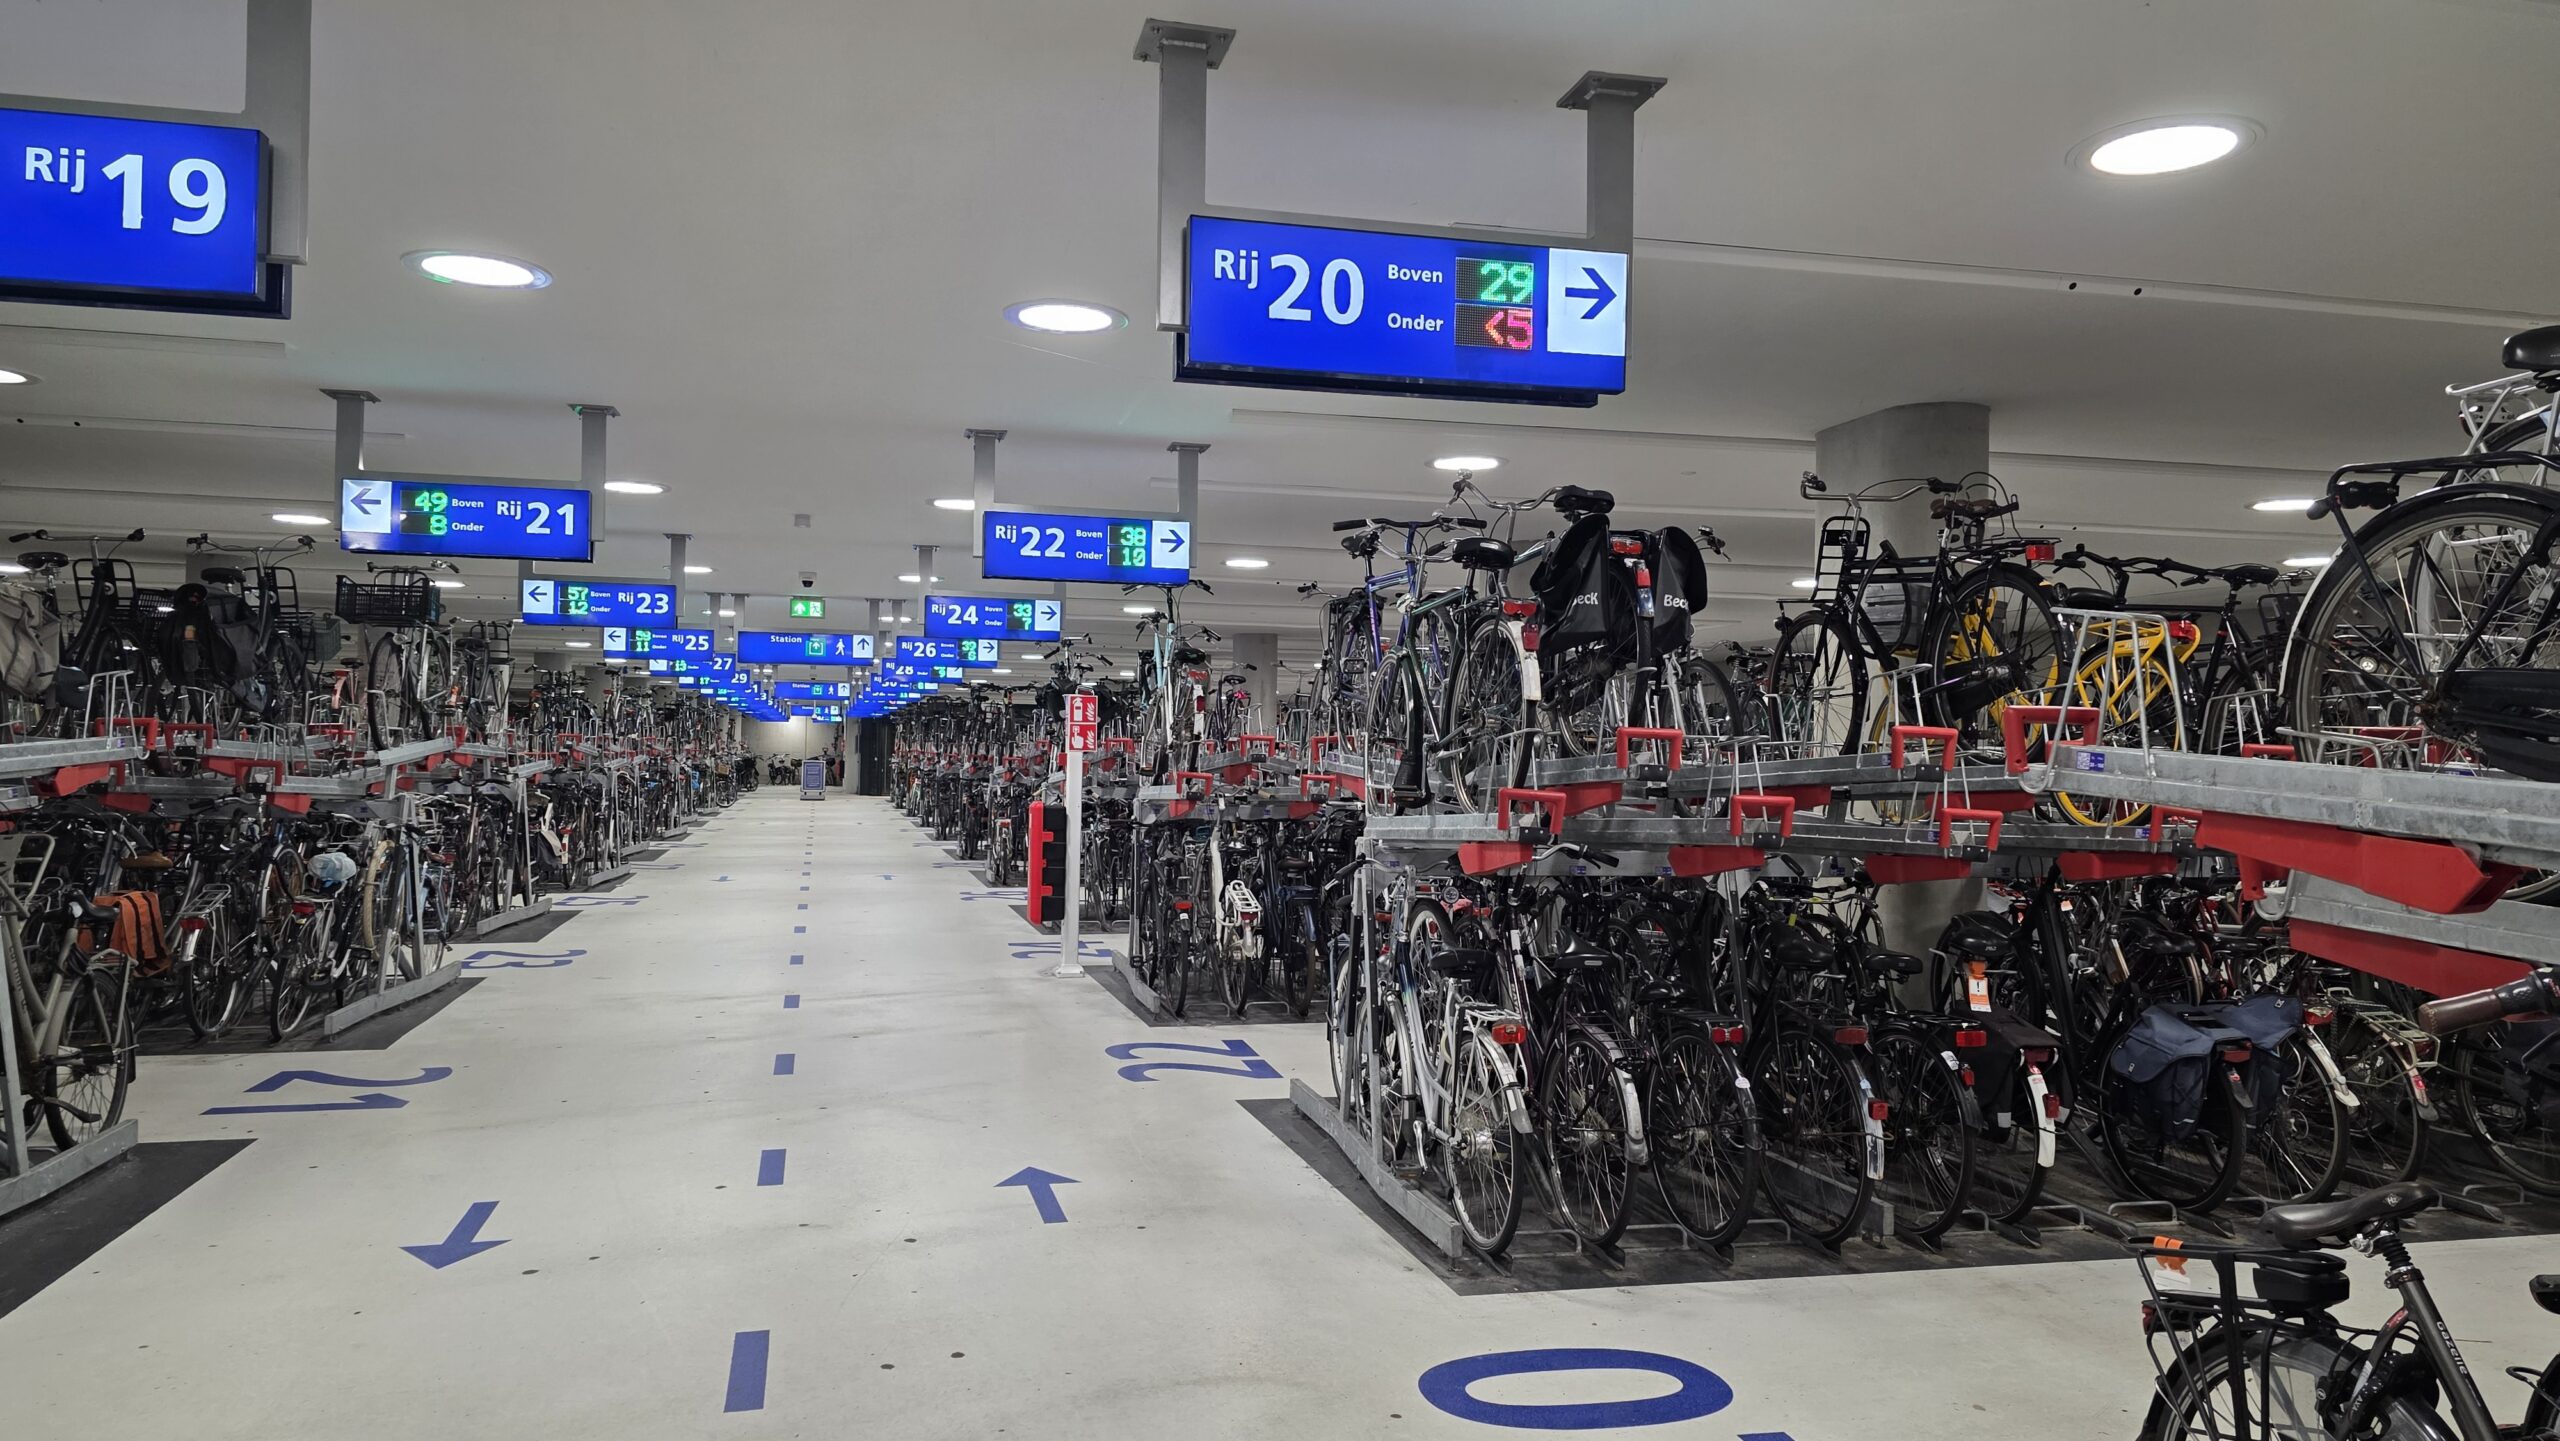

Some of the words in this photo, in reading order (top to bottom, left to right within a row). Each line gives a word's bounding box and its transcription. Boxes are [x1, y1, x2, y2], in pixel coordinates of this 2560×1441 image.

[25, 146, 86, 193] Rij
[101, 153, 227, 235] 19
[1213, 248, 1260, 290] Rij
[1267, 253, 1366, 326] 20
[1387, 264, 1443, 284] Boven
[1479, 261, 1534, 304] 29
[1386, 312, 1444, 333] Onder
[414, 491, 448, 513] 49
[451, 498, 485, 509] Boven
[496, 500, 522, 520] Rij
[525, 501, 575, 536] 21
[429, 515, 448, 535] 8
[451, 522, 485, 533] Onder
[995, 525, 1017, 544] Rij
[1019, 526, 1066, 559] 22
[1075, 529, 1103, 539] Boven
[1120, 527, 1147, 547] 38
[1075, 551, 1104, 560] Onder
[1121, 547, 1146, 567] 10
[617, 592, 635, 605] Rij
[635, 592, 669, 614] 23
[931, 604, 946, 616] Rij
[947, 604, 979, 625] 24
[672, 634, 684, 644] Rij
[684, 635, 709, 651] 25
[770, 635, 802, 643] Station
[901, 641, 913, 651] Rij
[913, 641, 937, 657] 26
[712, 657, 733, 671] 27
[730, 672, 748, 684] 29
[461, 949, 588, 969] 23
[1104, 1039, 1284, 1082] 22
[199, 1067, 453, 1116] 21
[2436, 1321, 2467, 1375] Gazelle
